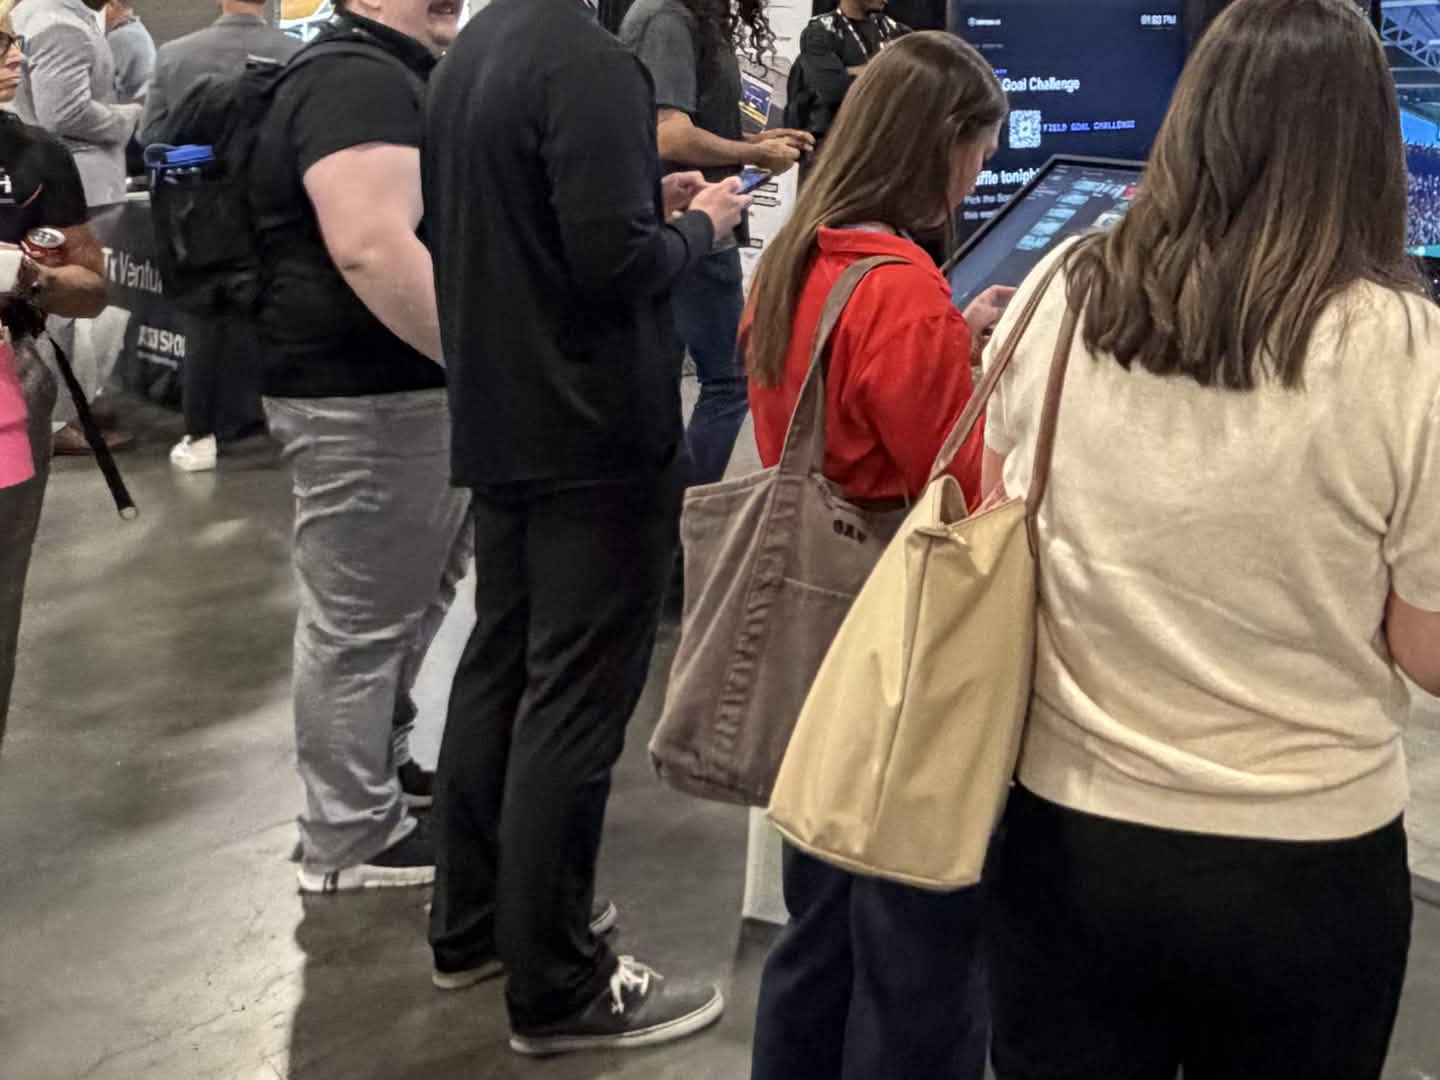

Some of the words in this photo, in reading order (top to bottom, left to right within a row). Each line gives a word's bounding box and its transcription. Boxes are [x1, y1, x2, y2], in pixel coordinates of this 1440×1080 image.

[1002, 77, 1027, 92] Goal
[1029, 76, 1080, 93] Challenge
[1043, 122, 1068, 132] FIELD
[1070, 122, 1090, 131] GOAL
[1093, 120, 1136, 130] CHALLENGE
